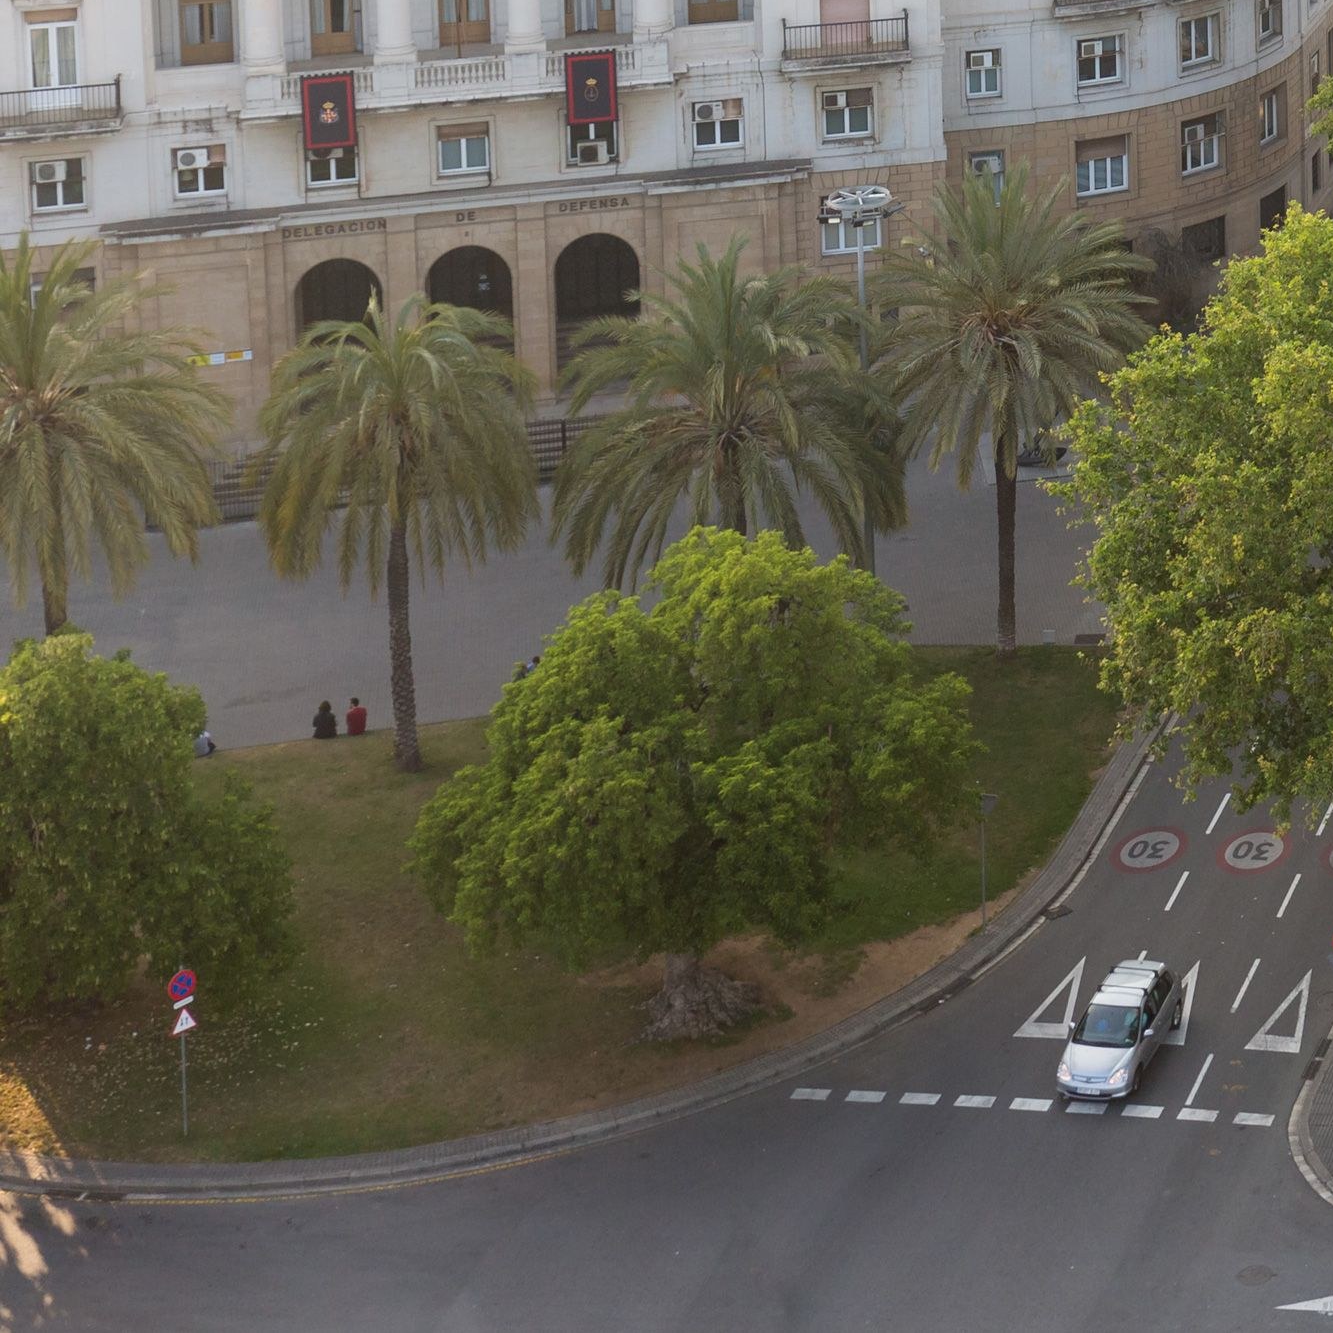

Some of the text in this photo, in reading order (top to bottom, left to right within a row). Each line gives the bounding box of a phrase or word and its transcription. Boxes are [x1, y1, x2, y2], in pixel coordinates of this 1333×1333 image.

[456, 211, 476, 223] DE
[559, 197, 631, 213] DEFENSA
[1127, 840, 1171, 859] 30
[1232, 840, 1275, 861] 30
